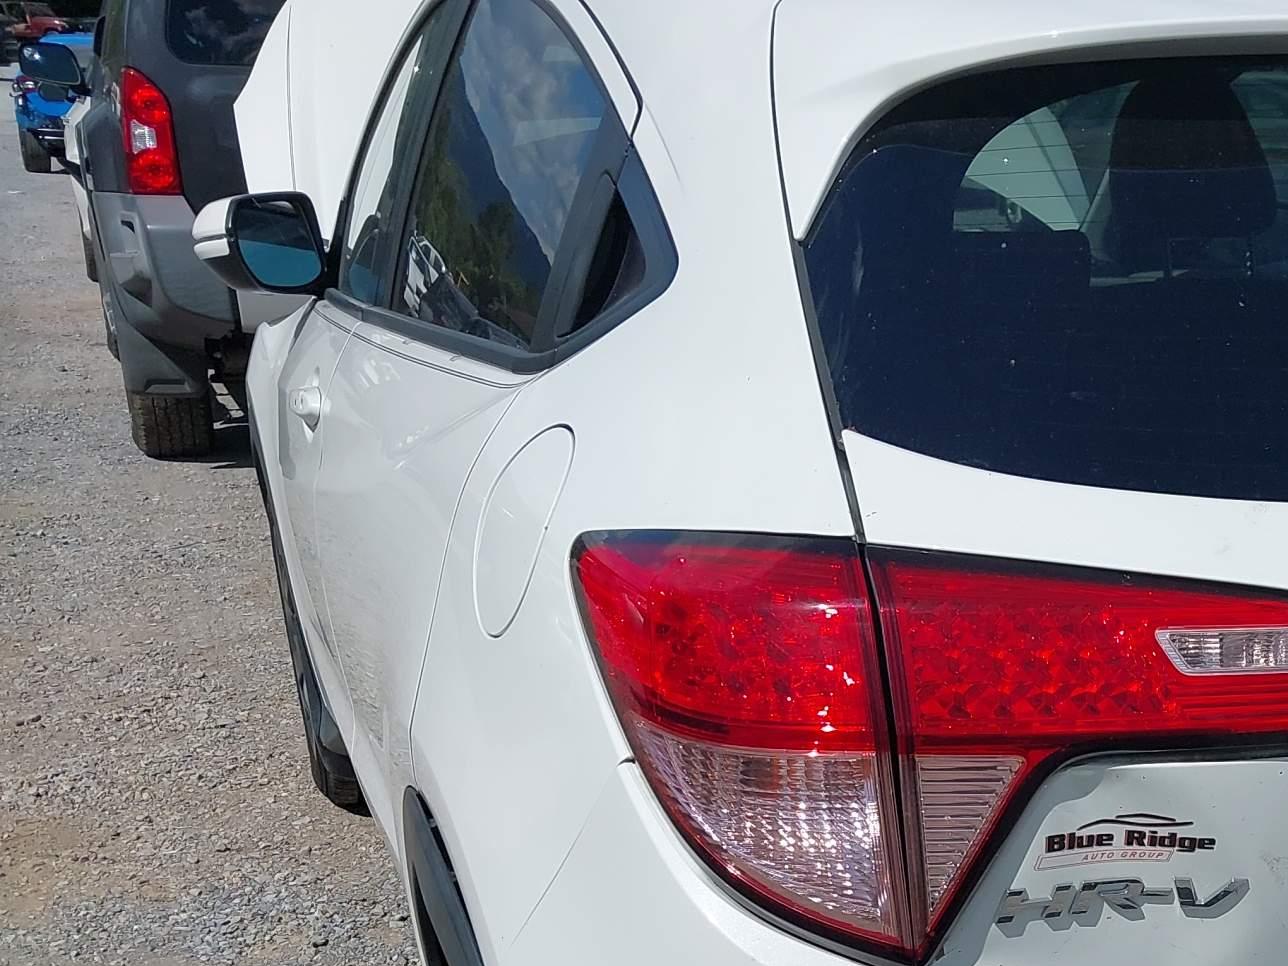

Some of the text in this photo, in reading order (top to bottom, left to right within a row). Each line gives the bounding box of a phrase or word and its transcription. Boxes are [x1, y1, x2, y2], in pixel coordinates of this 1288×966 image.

[1045, 829, 1217, 853] Blue Ridge
[1082, 850, 1164, 861] AUTO GROUP
[995, 876, 1250, 932] HR-V
